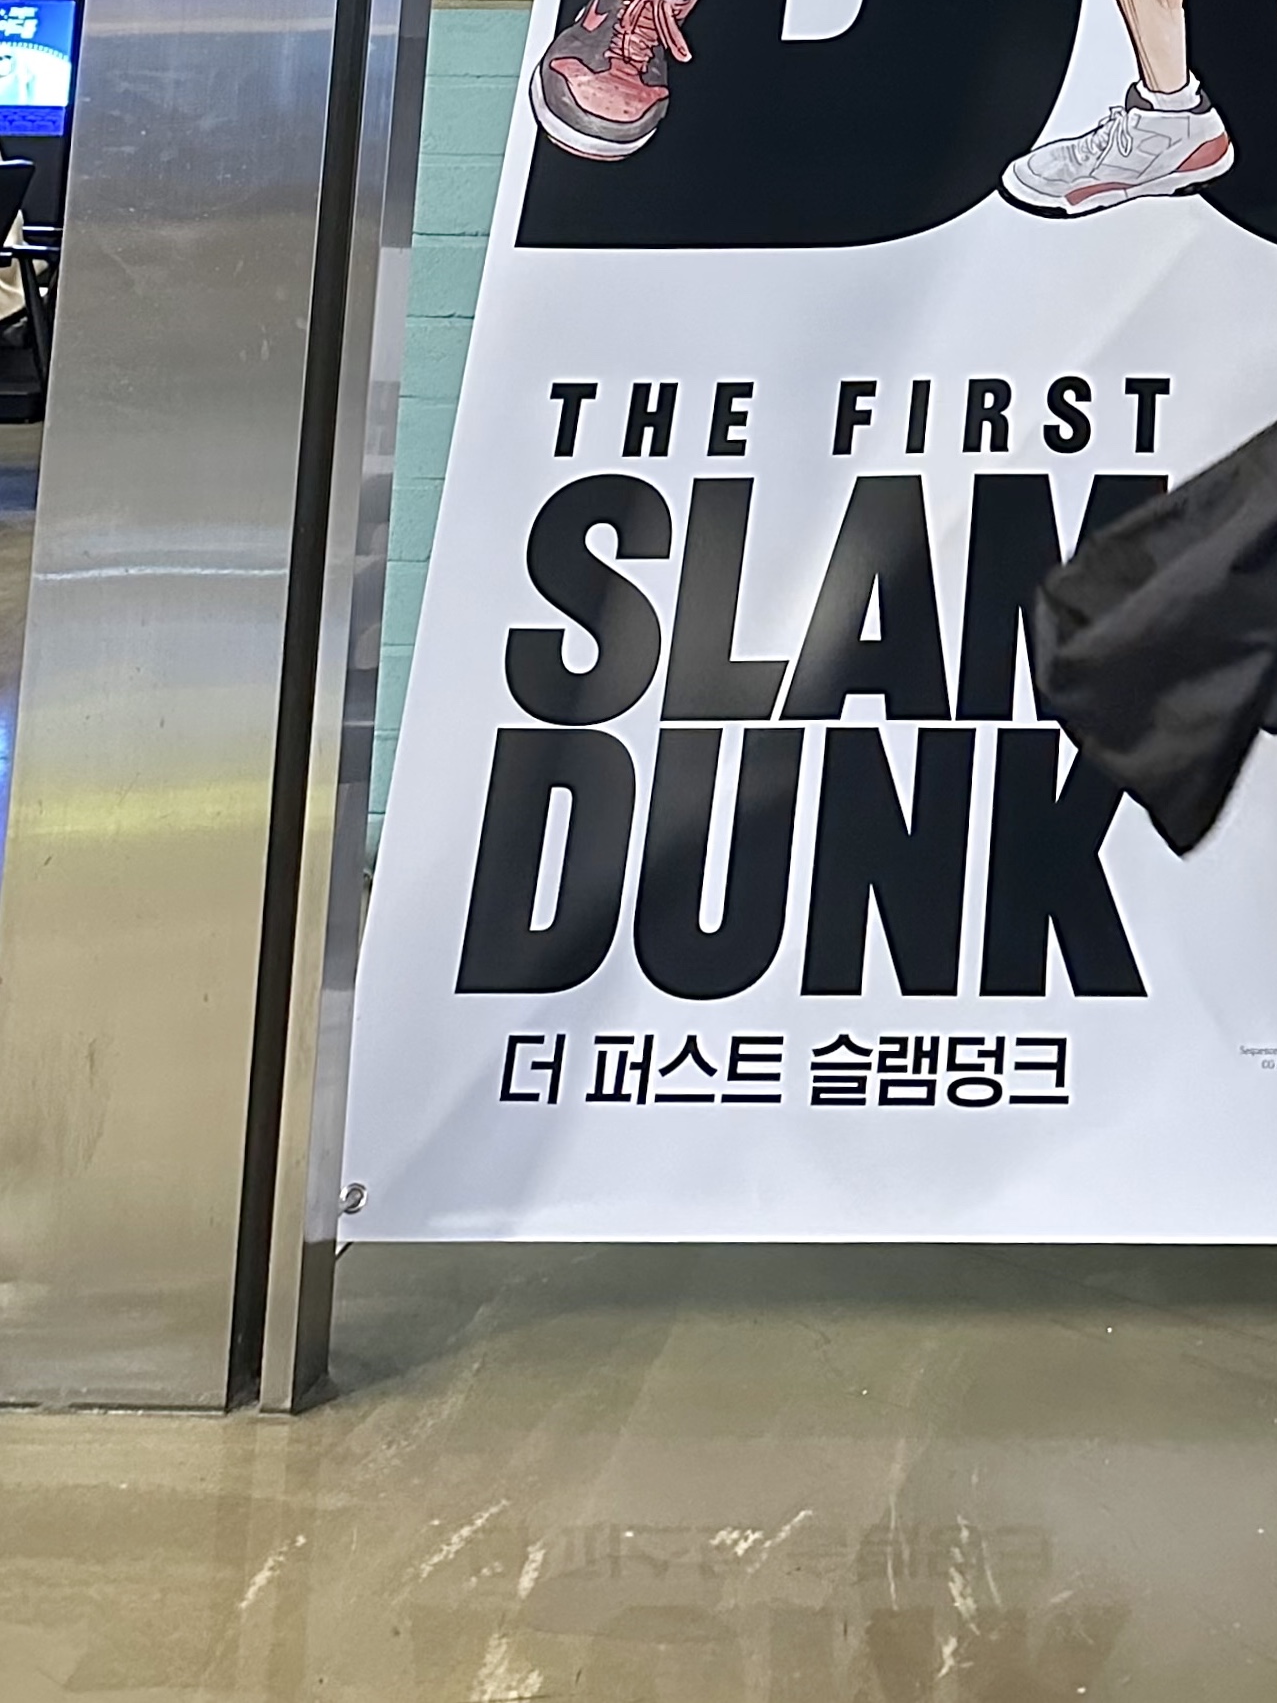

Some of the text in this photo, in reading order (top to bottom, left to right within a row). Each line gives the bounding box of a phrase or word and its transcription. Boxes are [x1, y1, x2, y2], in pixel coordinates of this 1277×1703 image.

[550, 376, 1171, 458] THE FIRST
[504, 473, 1169, 726] SLAM
[454, 727, 1148, 1000] DUNK
[499, 1034, 1070, 1106] 더 퍼스트 슬램덩크
